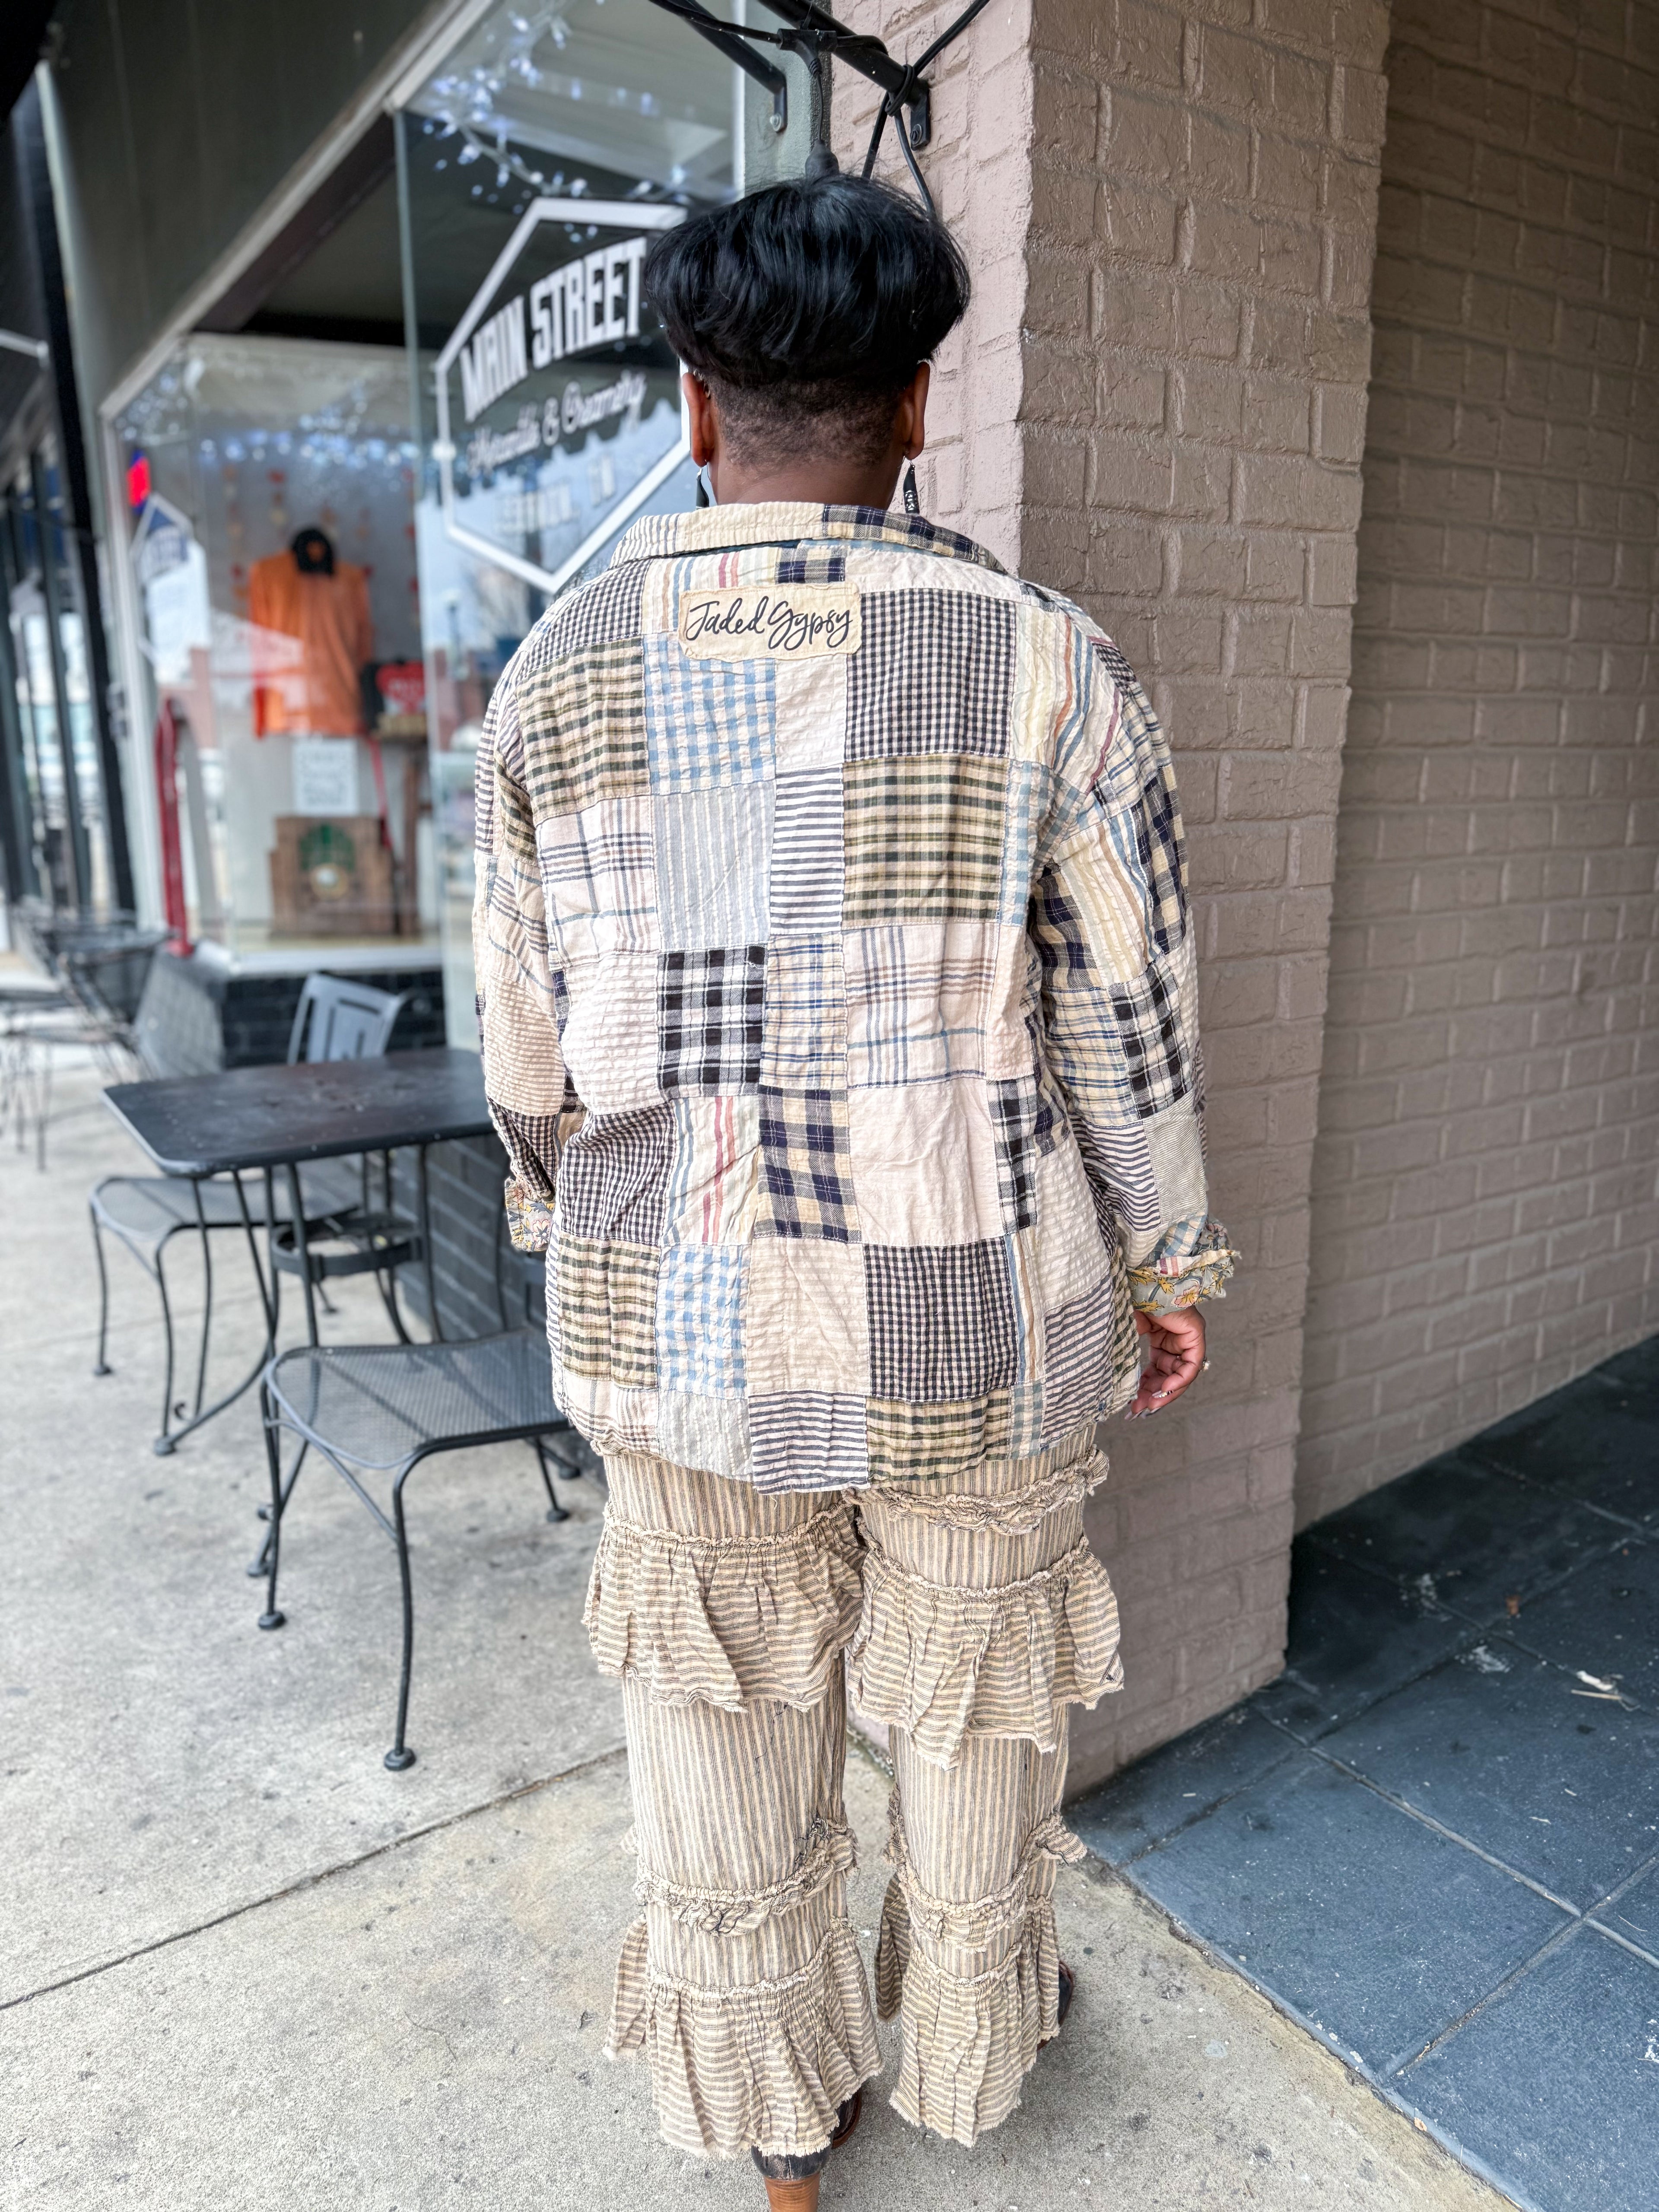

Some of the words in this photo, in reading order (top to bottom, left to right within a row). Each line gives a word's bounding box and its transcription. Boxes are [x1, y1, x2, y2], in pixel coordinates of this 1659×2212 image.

[460, 296, 528, 422] MAIN
[530, 237, 646, 369] STREET
[542, 397, 560, 446] &
[686, 596, 769, 641] Jaded
[767, 601, 853, 651] Gypsy
